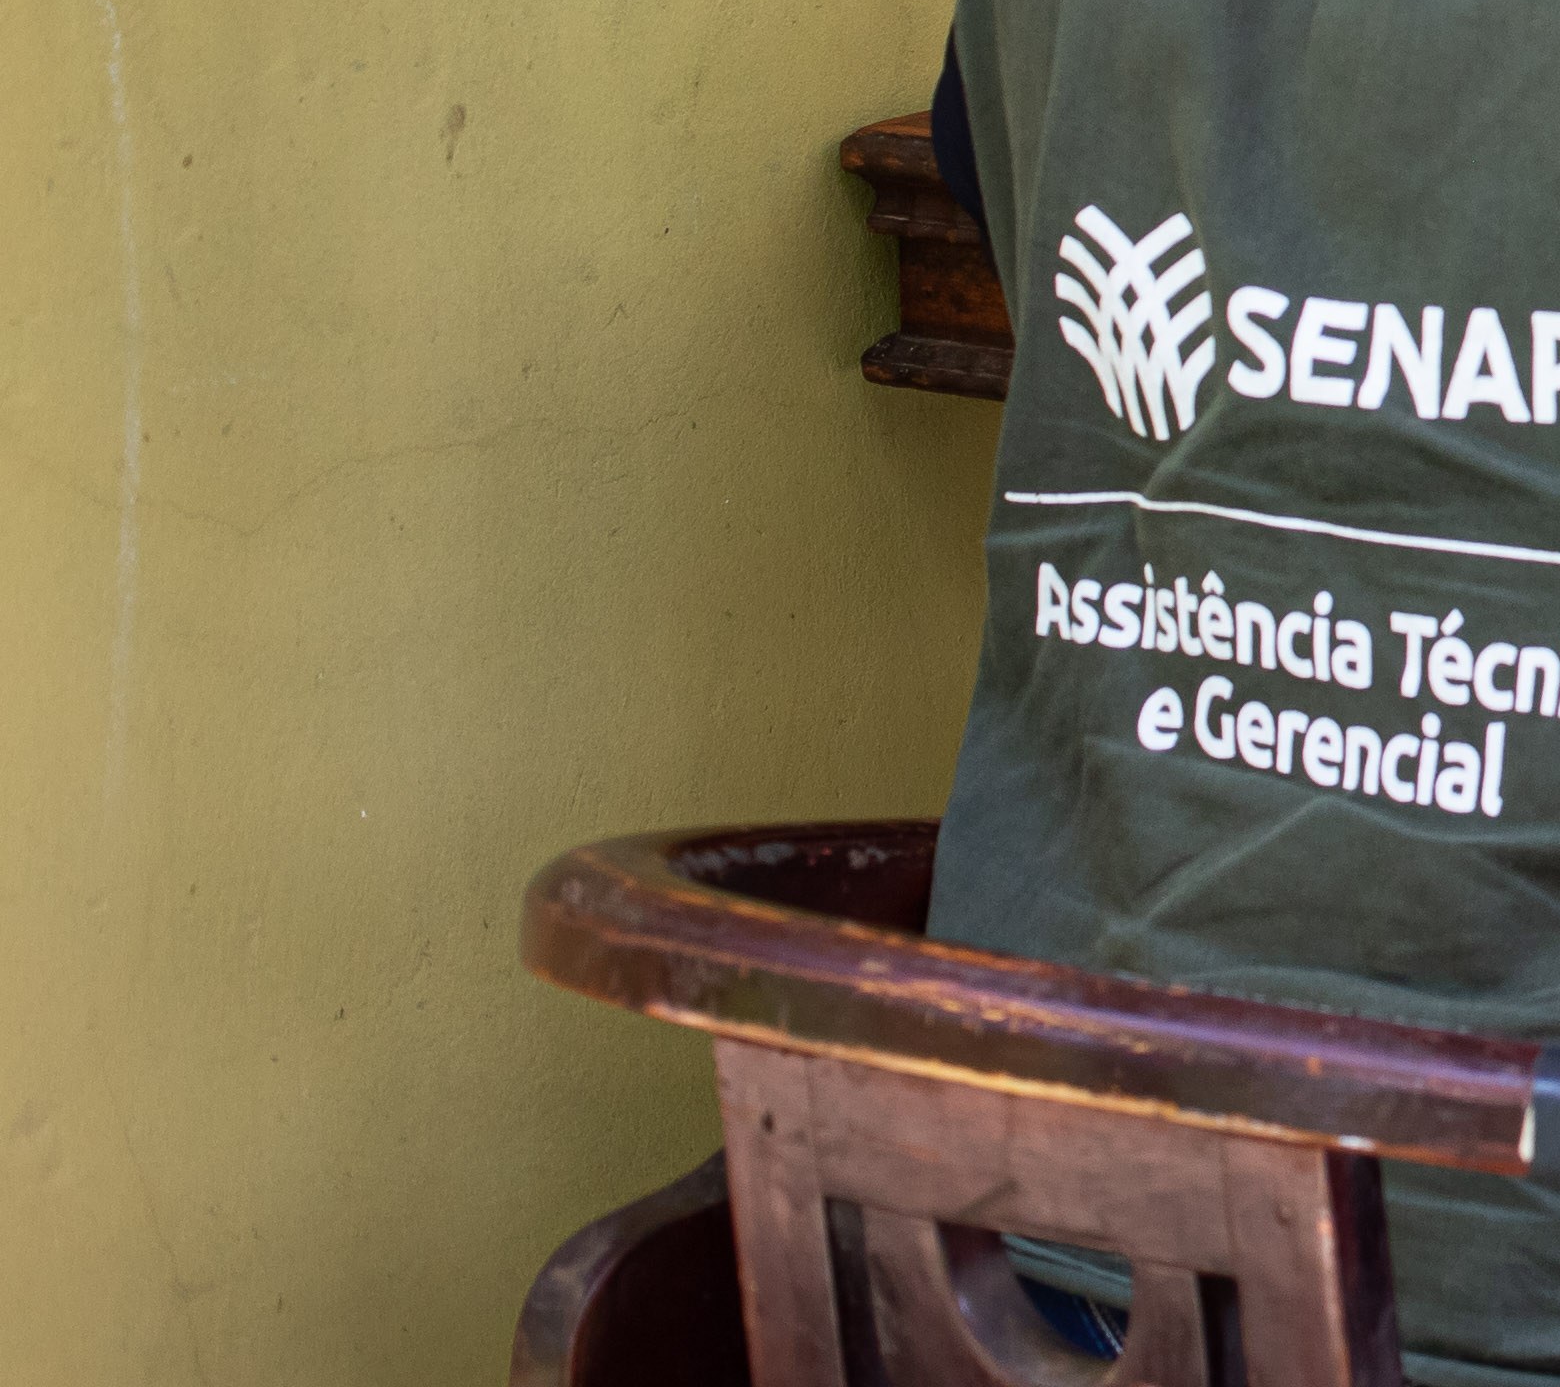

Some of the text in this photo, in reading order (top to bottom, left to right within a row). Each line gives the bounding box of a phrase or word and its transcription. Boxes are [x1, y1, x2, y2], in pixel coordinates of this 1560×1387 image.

[1035, 562, 1372, 691] Assistência
[1137, 674, 1505, 818] e Gerencial
